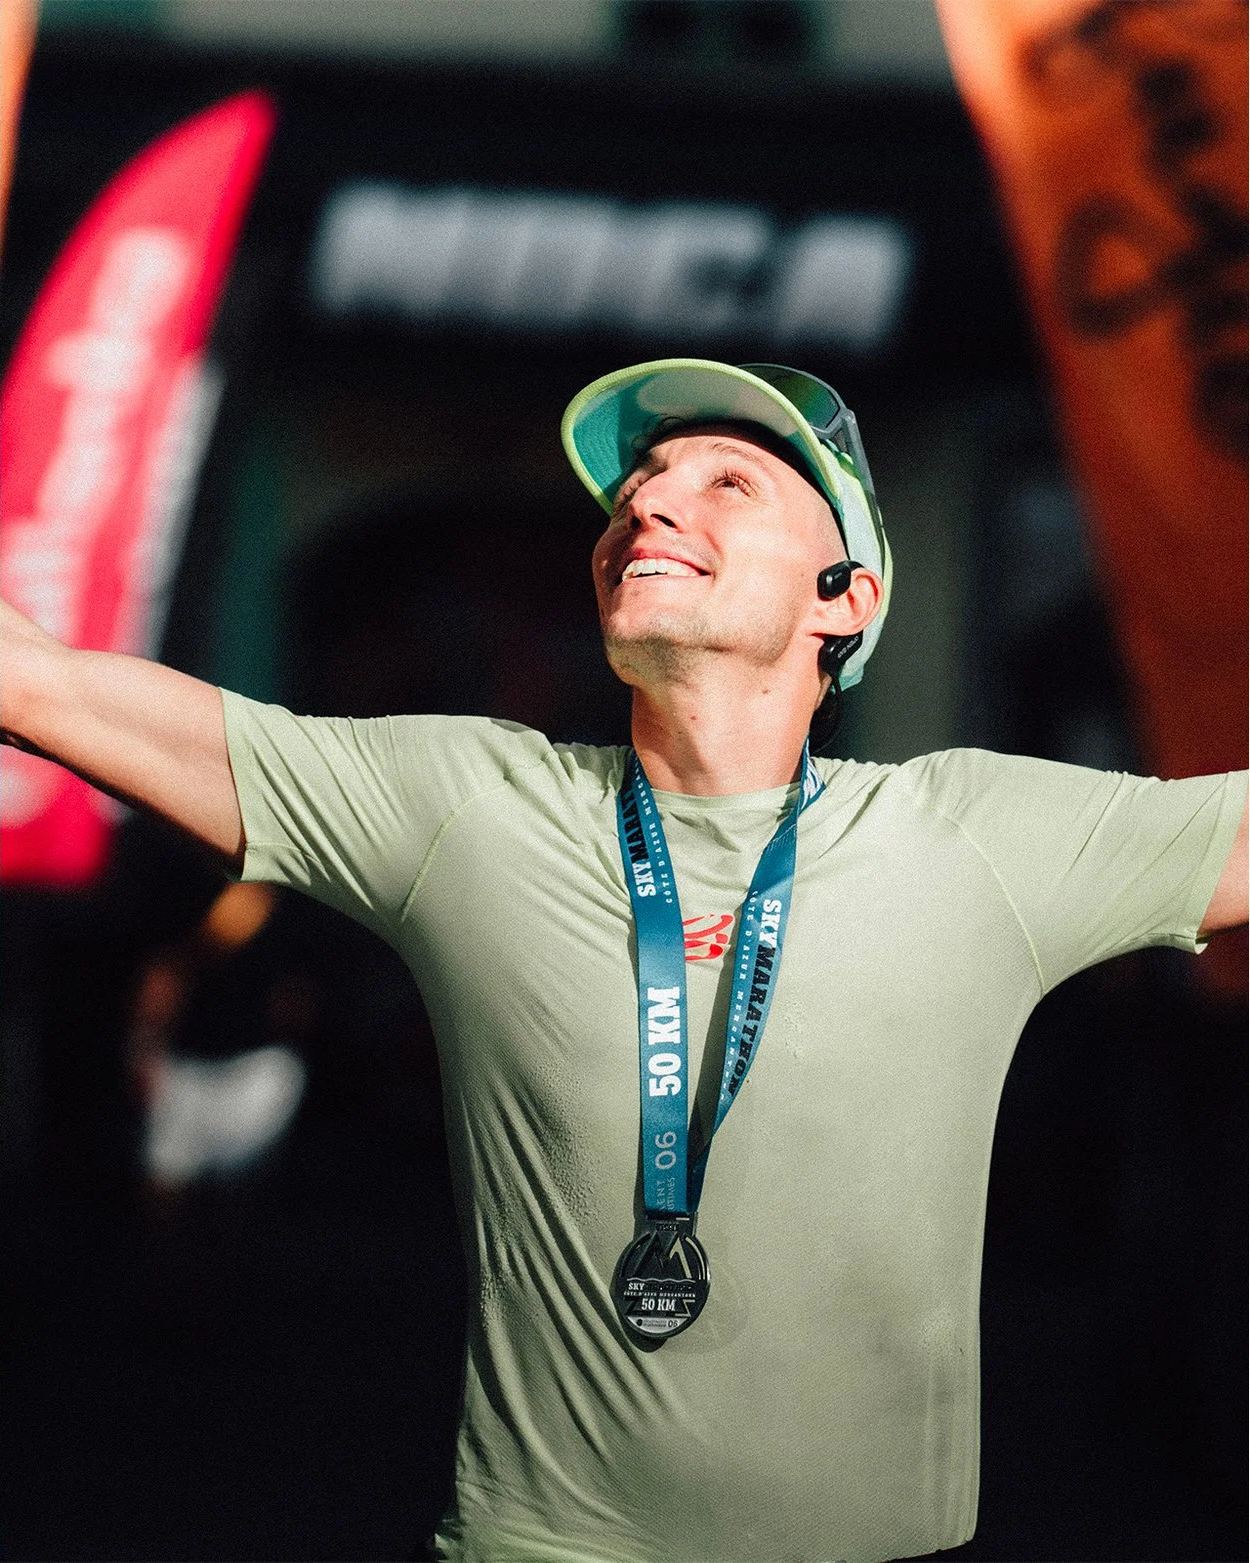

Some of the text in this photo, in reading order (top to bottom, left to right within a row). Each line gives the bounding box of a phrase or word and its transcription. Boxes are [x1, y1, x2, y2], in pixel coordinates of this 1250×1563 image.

[729, 899, 783, 1096] SKYMARATHON
[647, 986, 682, 1097] 50 KM
[655, 1130, 677, 1170] 06
[641, 1298, 676, 1311] 50 KM
